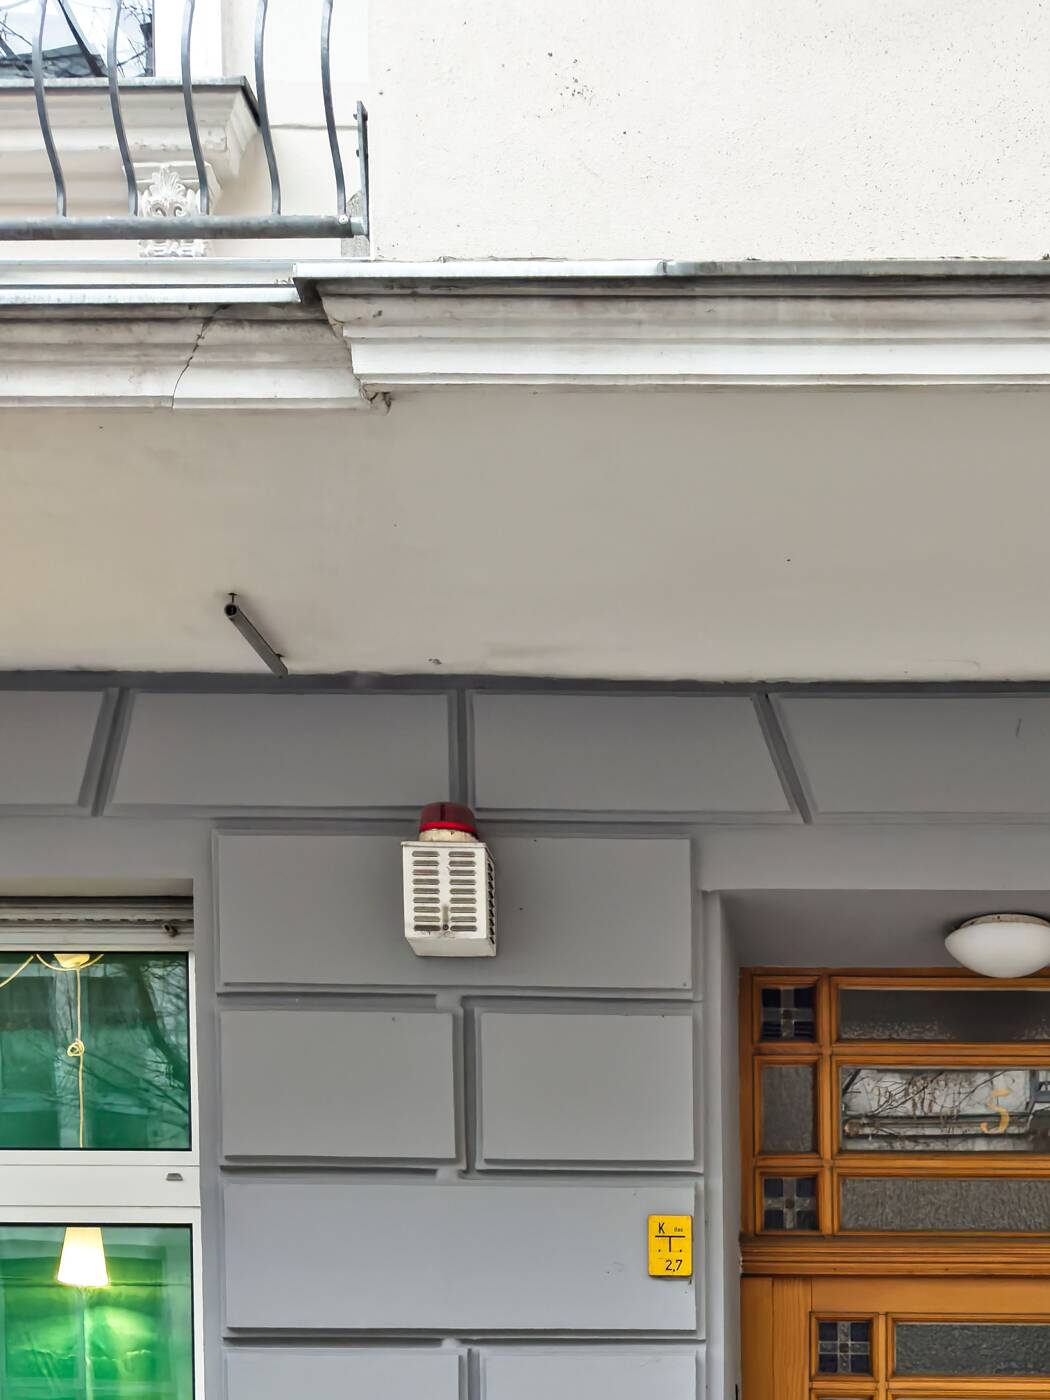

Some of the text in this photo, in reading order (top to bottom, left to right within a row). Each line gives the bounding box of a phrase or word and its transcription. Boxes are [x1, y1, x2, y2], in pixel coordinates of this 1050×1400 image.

[979, 1087, 1012, 1135] 5
[658, 1222, 665, 1234] K
[665, 1259, 683, 1272] 2,7
